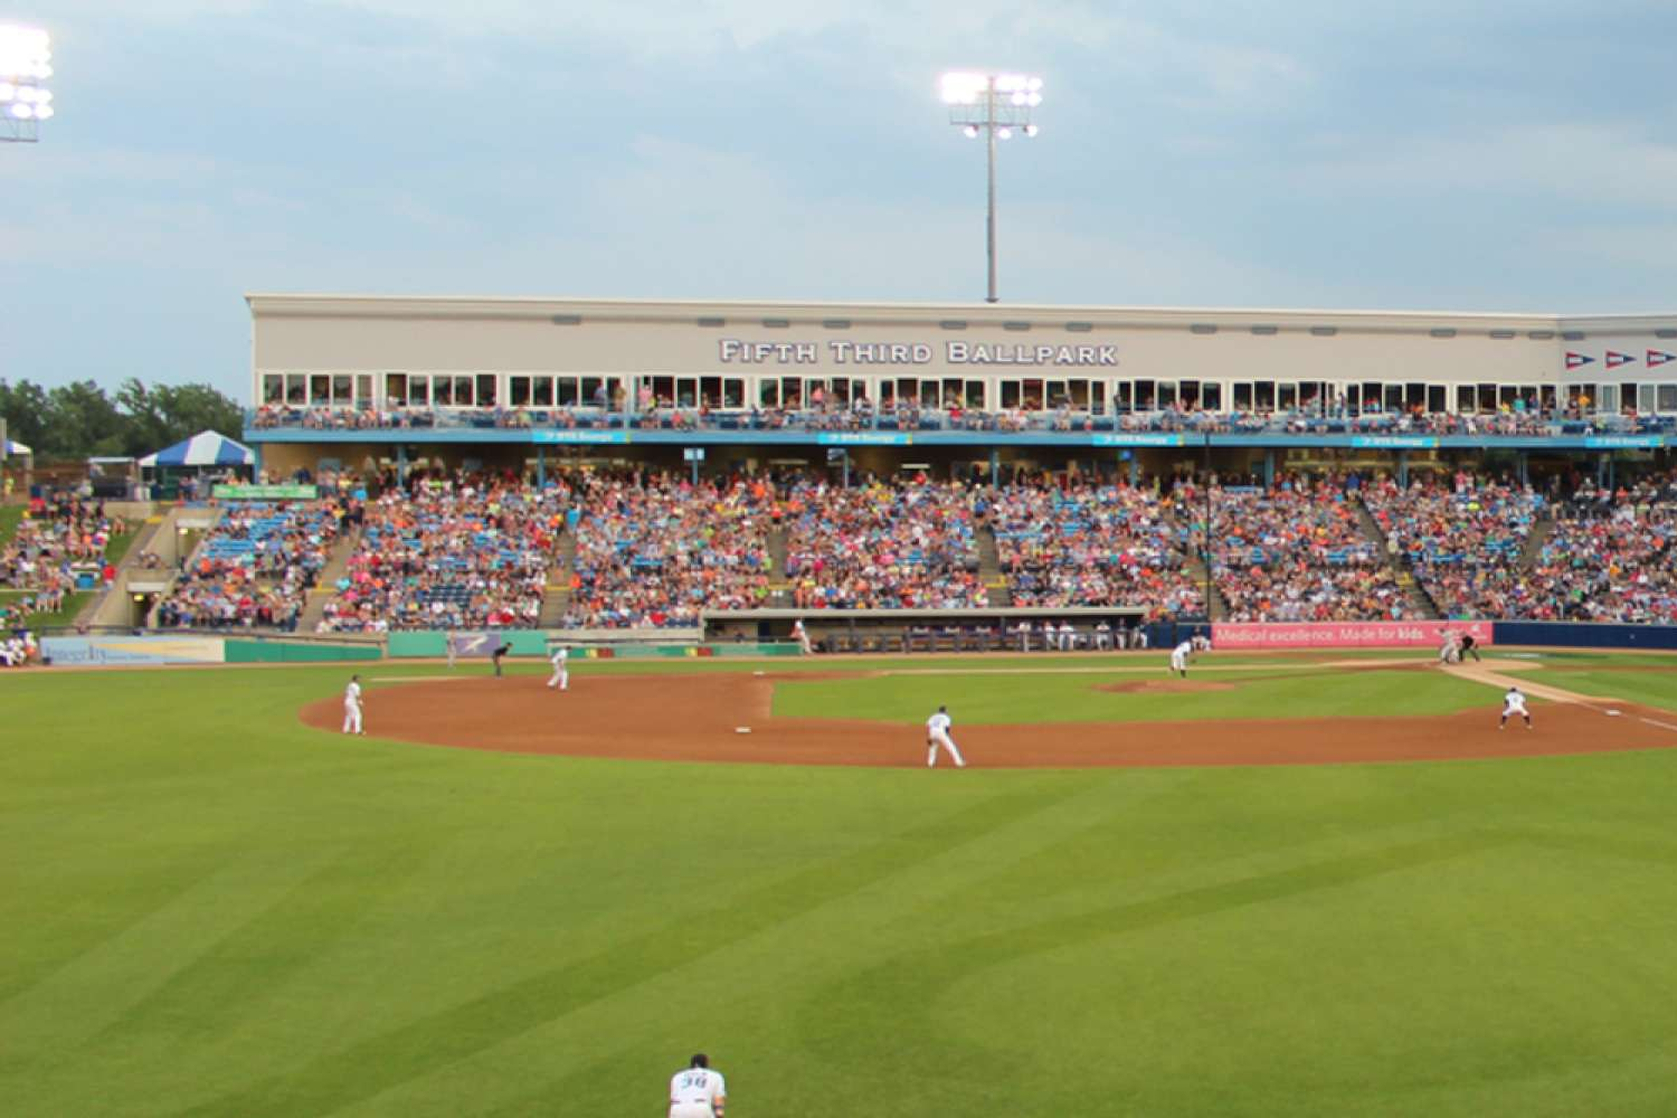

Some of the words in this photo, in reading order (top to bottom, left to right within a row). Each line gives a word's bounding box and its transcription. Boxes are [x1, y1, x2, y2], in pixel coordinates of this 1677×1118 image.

[720, 339, 817, 364] FIFTH
[829, 340, 933, 365] THIRD
[946, 340, 1119, 367] BALLPARK
[1216, 628, 1267, 642] Medical
[1269, 627, 1336, 642] excellence.
[1340, 628, 1375, 641] Made
[1377, 627, 1396, 641] for
[1397, 627, 1426, 641] kids.
